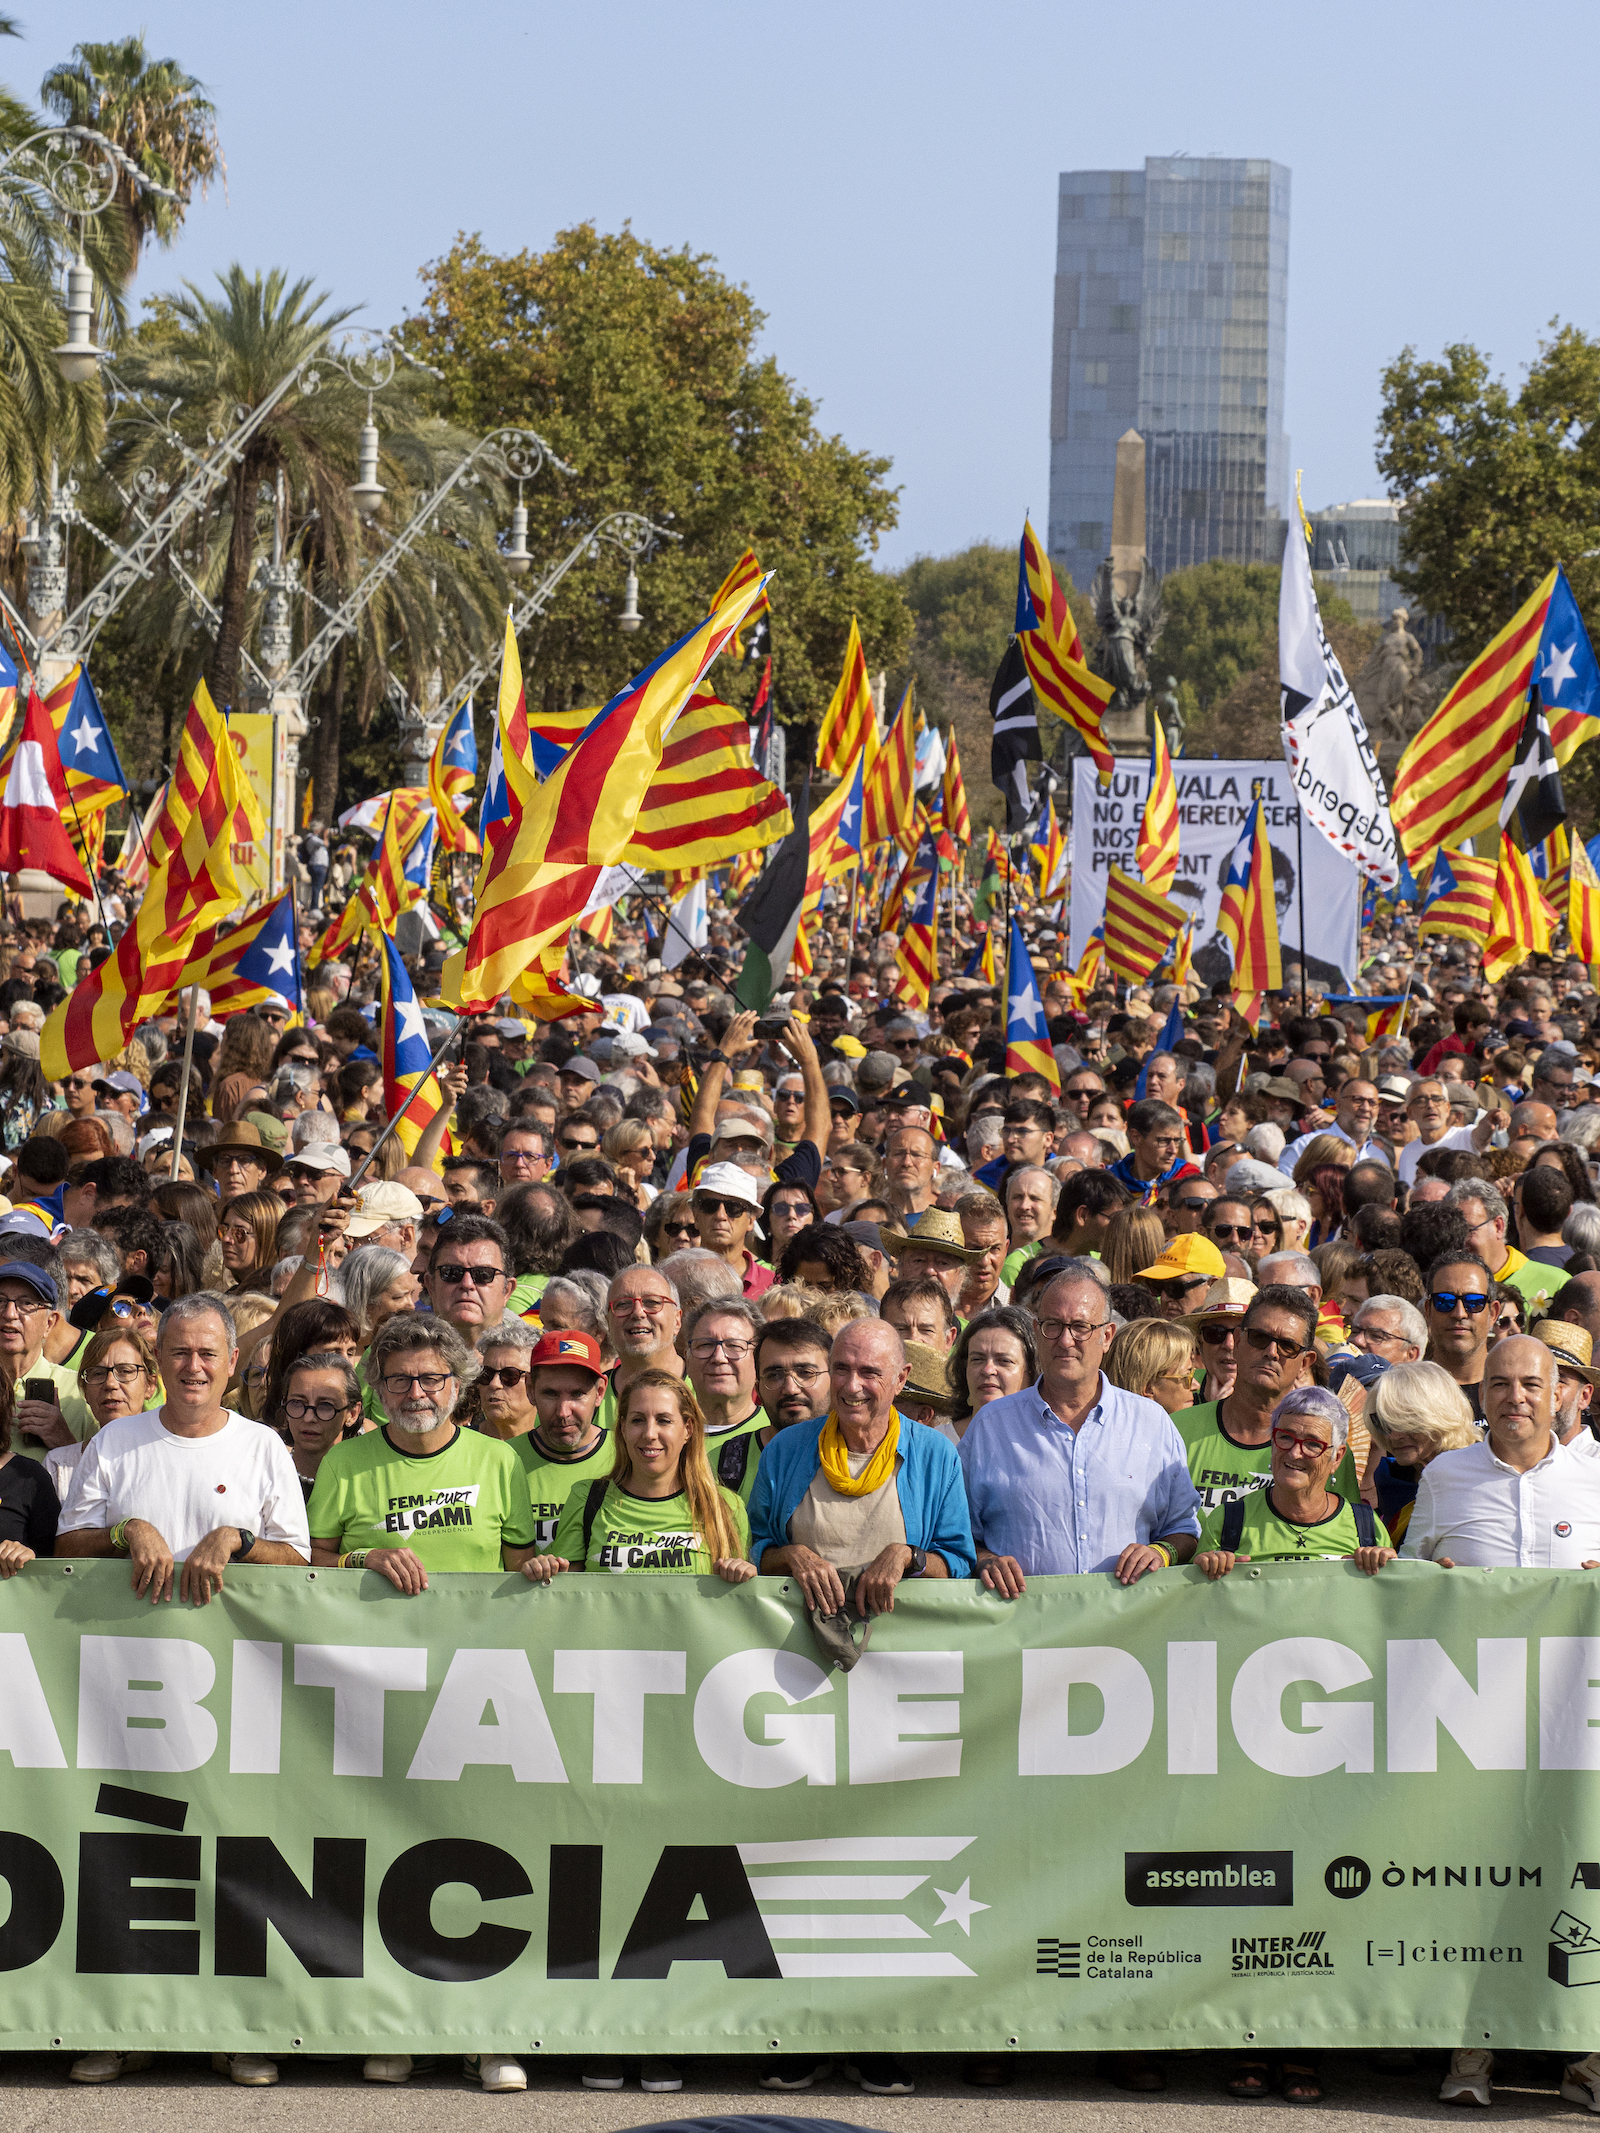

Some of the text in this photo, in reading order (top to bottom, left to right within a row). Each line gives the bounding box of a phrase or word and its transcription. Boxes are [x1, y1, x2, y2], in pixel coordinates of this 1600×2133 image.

[1251, 776, 1280, 801] EL
[1093, 802, 1123, 823] NO
[1093, 827, 1140, 848] NOS
[1201, 1470, 1239, 1488] FEM
[388, 1494, 424, 1511] FEM
[385, 1512, 410, 1533] EL
[413, 1527, 474, 1536] INDEPENDÈNCIA
[533, 1519, 548, 1541] L
[606, 1530, 644, 1546] FEM
[599, 1545, 623, 1568] EL
[1145, 1864, 1277, 1888] assemblea
[1381, 1860, 1542, 1888] ÒMNIUM
[1087, 1935, 1143, 1948] Consell
[1231, 1937, 1294, 1954] INTER
[1087, 1951, 1202, 1965] de la República
[1231, 1952, 1334, 1971] SINDICAL
[1086, 1966, 1153, 1979] Catalana
